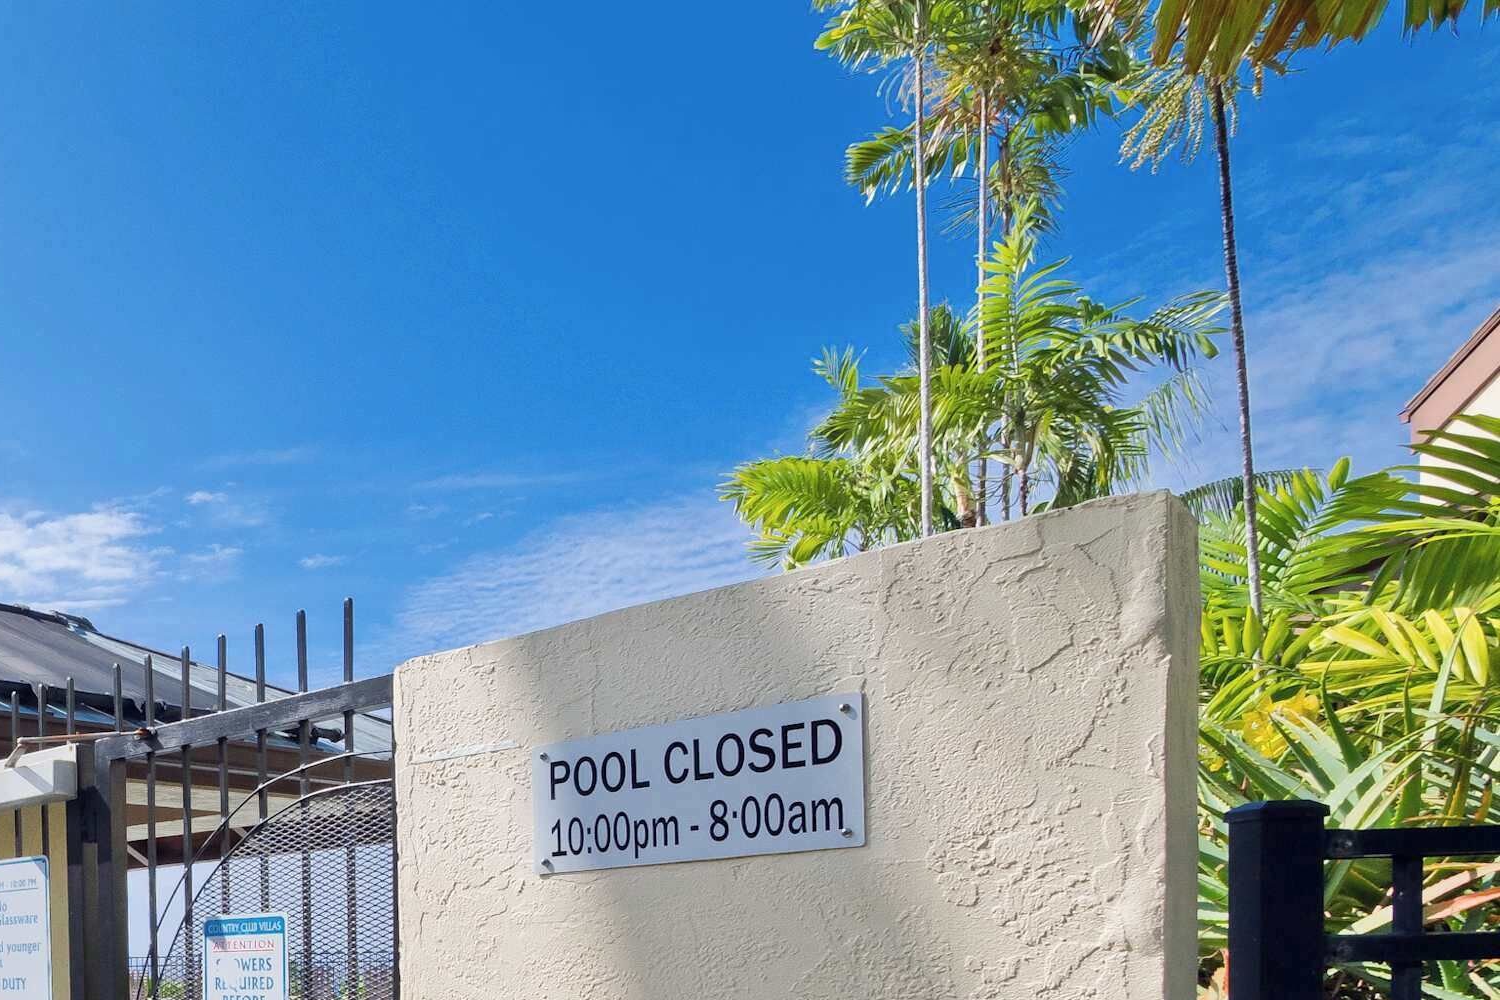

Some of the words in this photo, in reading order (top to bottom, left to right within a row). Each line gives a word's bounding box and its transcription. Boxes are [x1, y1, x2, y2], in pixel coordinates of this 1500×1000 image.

[549, 749, 650, 800] POOL
[664, 718, 843, 784] CLOSED
[551, 811, 680, 859] 10:00pm
[259, 921, 282, 931] VILLAS
[7, 942, 41, 956] younger
[2, 977, 27, 990] DUTY
